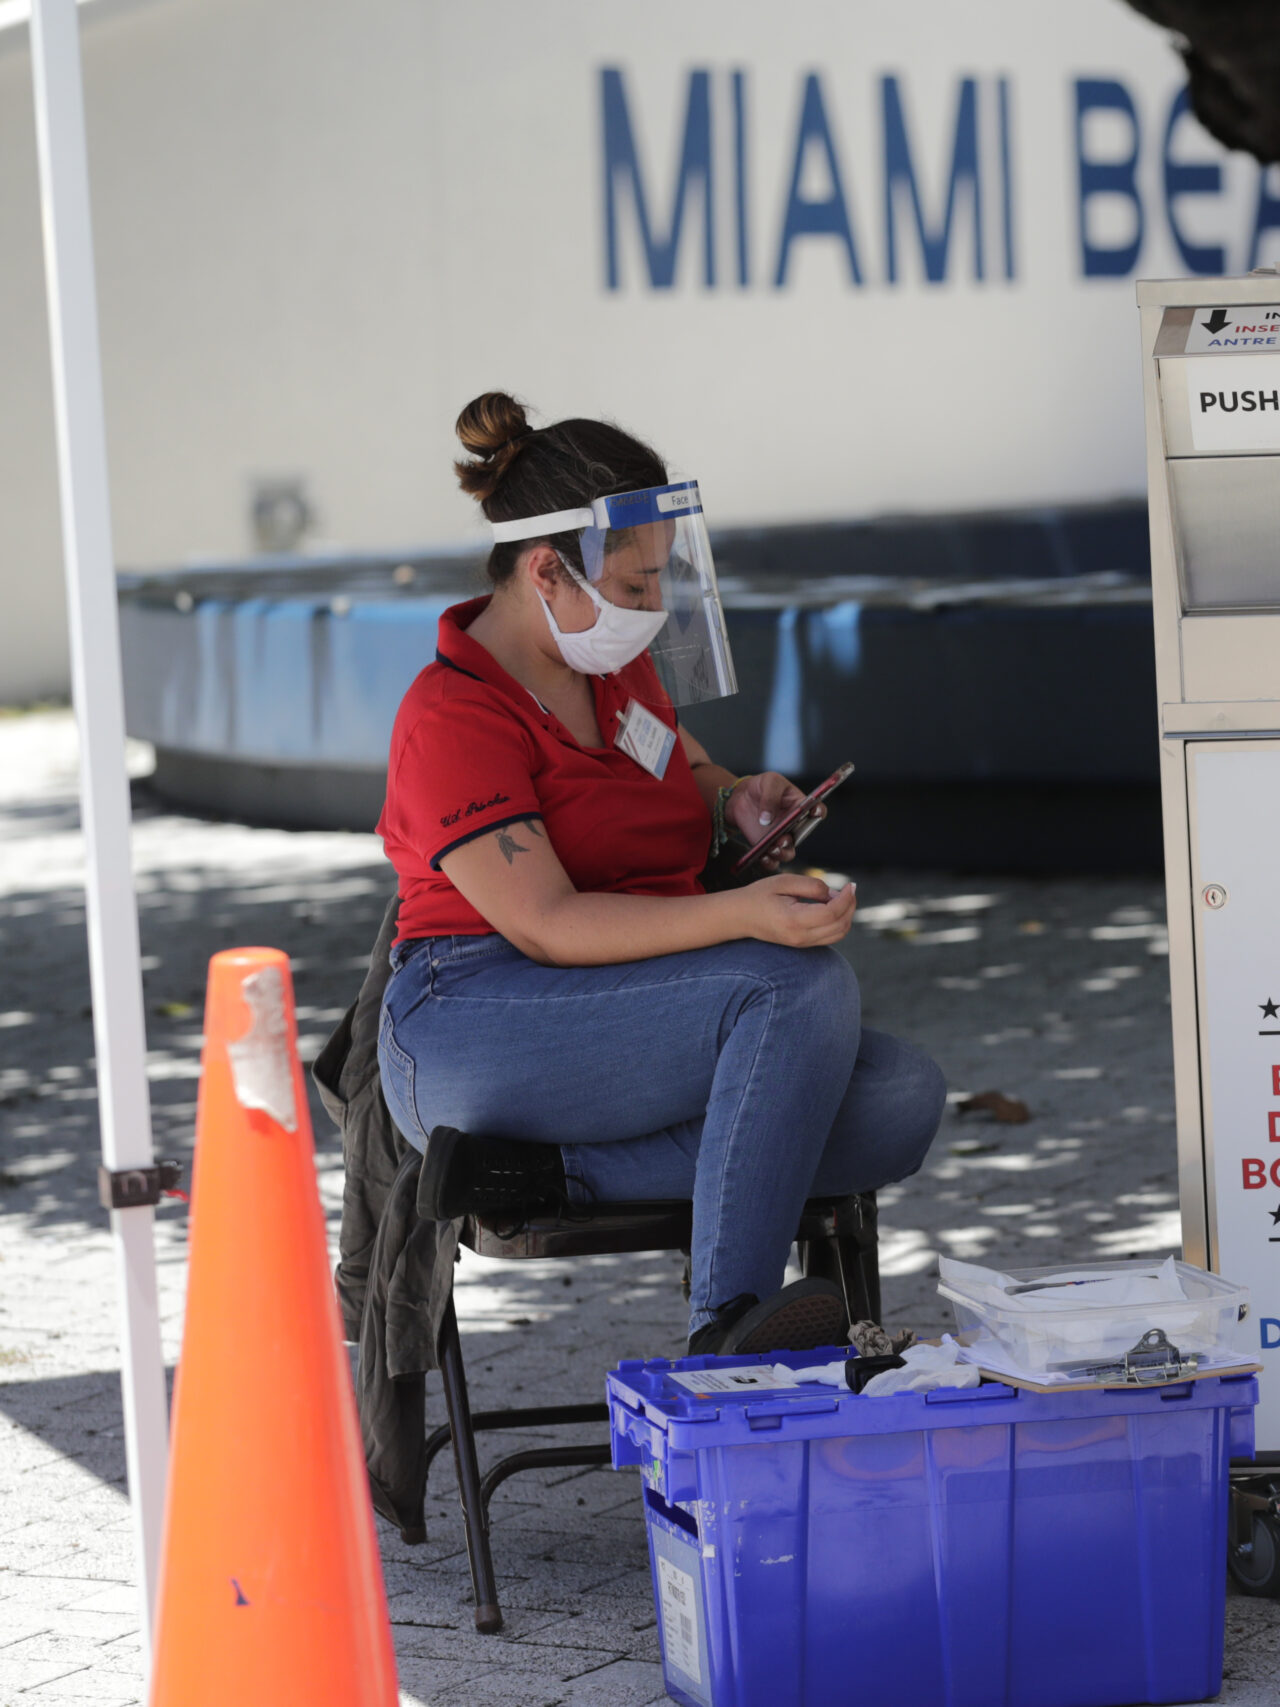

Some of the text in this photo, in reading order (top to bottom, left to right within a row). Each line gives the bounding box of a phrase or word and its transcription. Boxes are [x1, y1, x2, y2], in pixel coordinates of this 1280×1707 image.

[598, 67, 1020, 290] MIAMI
[1208, 335, 1280, 346] ANTRE
[1200, 389, 1279, 413] PUSH
[671, 495, 689, 506] Face
